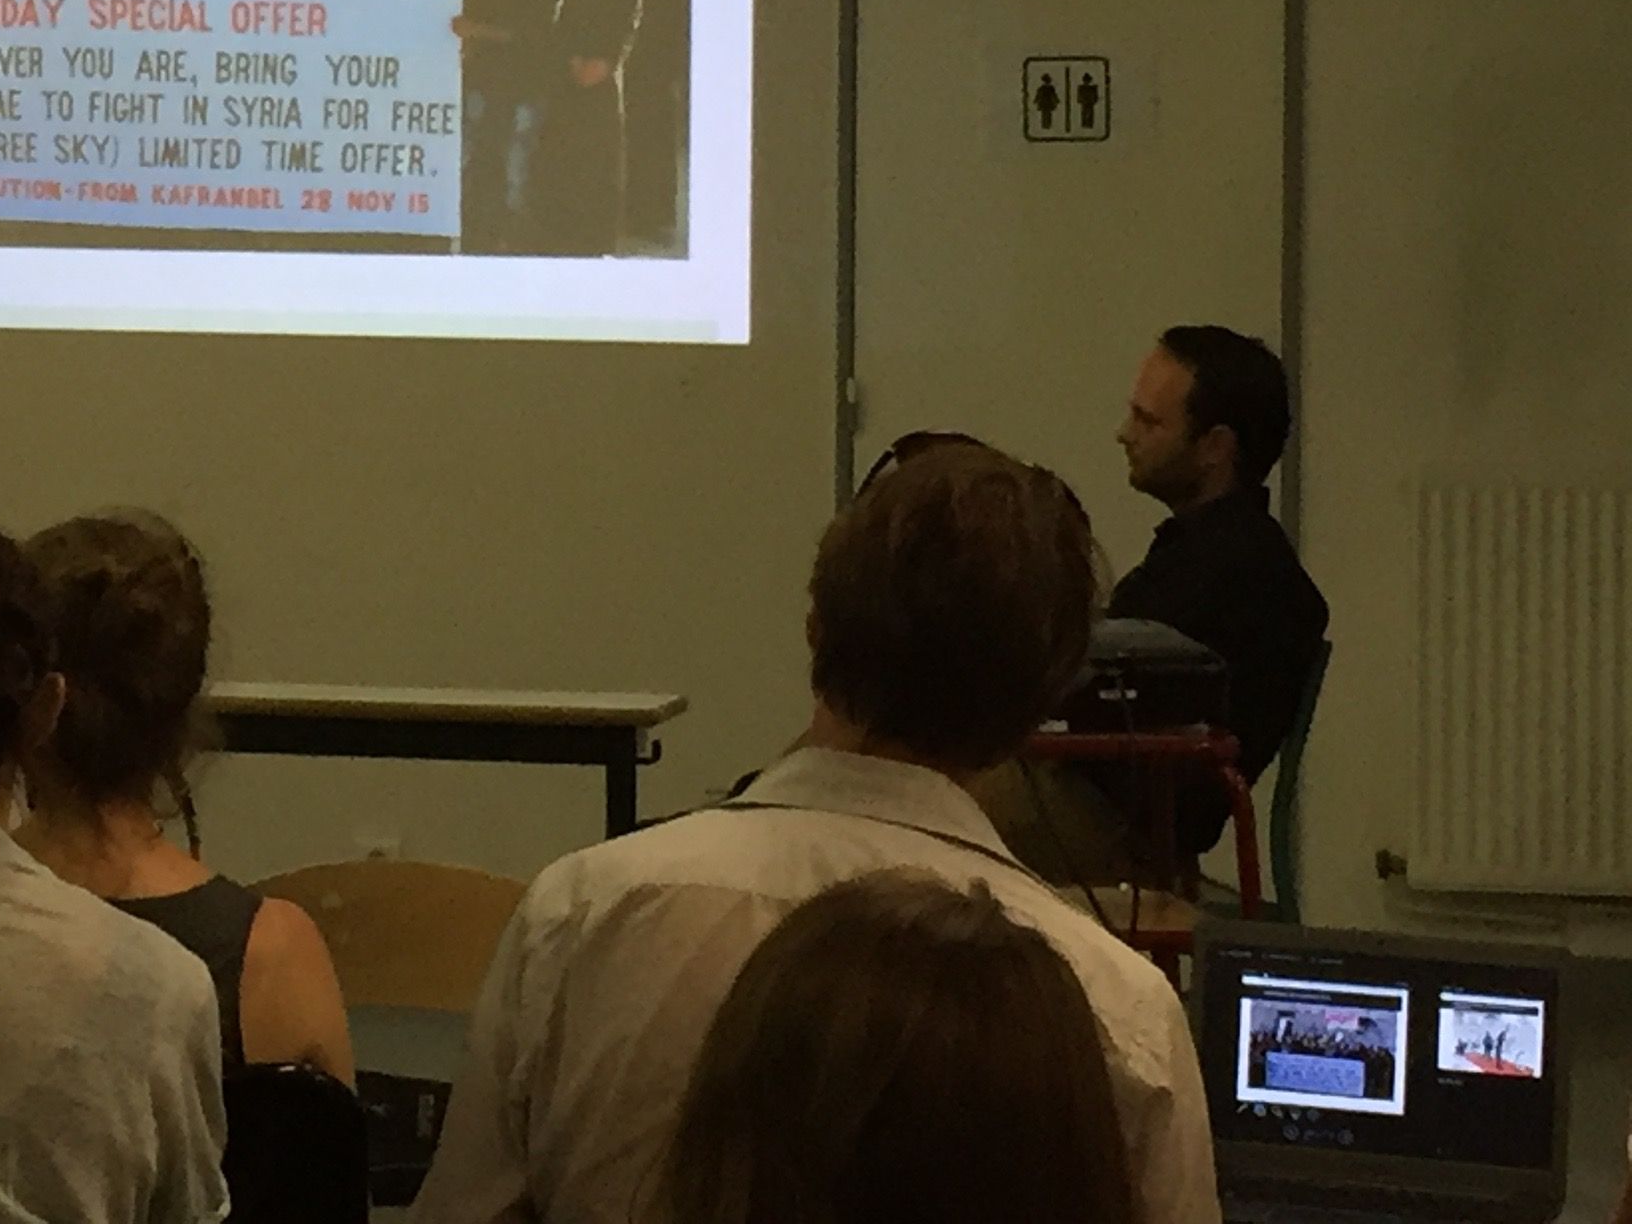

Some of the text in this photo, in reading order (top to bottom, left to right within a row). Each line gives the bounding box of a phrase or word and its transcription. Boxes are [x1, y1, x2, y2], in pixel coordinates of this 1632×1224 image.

[231, 0, 328, 37] OFFER
[62, 46, 114, 79] YOU
[134, 49, 198, 87] ARE,
[214, 50, 299, 87] BRING
[324, 53, 401, 89] YOUR
[40, 89, 76, 123] TO
[87, 90, 165, 125] FIGHT
[182, 94, 209, 126] IN
[223, 95, 303, 130] SYRIA
[323, 98, 370, 132] FOR
[390, 100, 457, 137] FREE
[52, 132, 120, 168] SKY)
[138, 136, 242, 171] LIMITED
[260, 139, 324, 174] TIME
[339, 141, 439, 178] OFFER.
[150, 182, 285, 210] KAFRANBEL
[300, 188, 333, 213] 28
